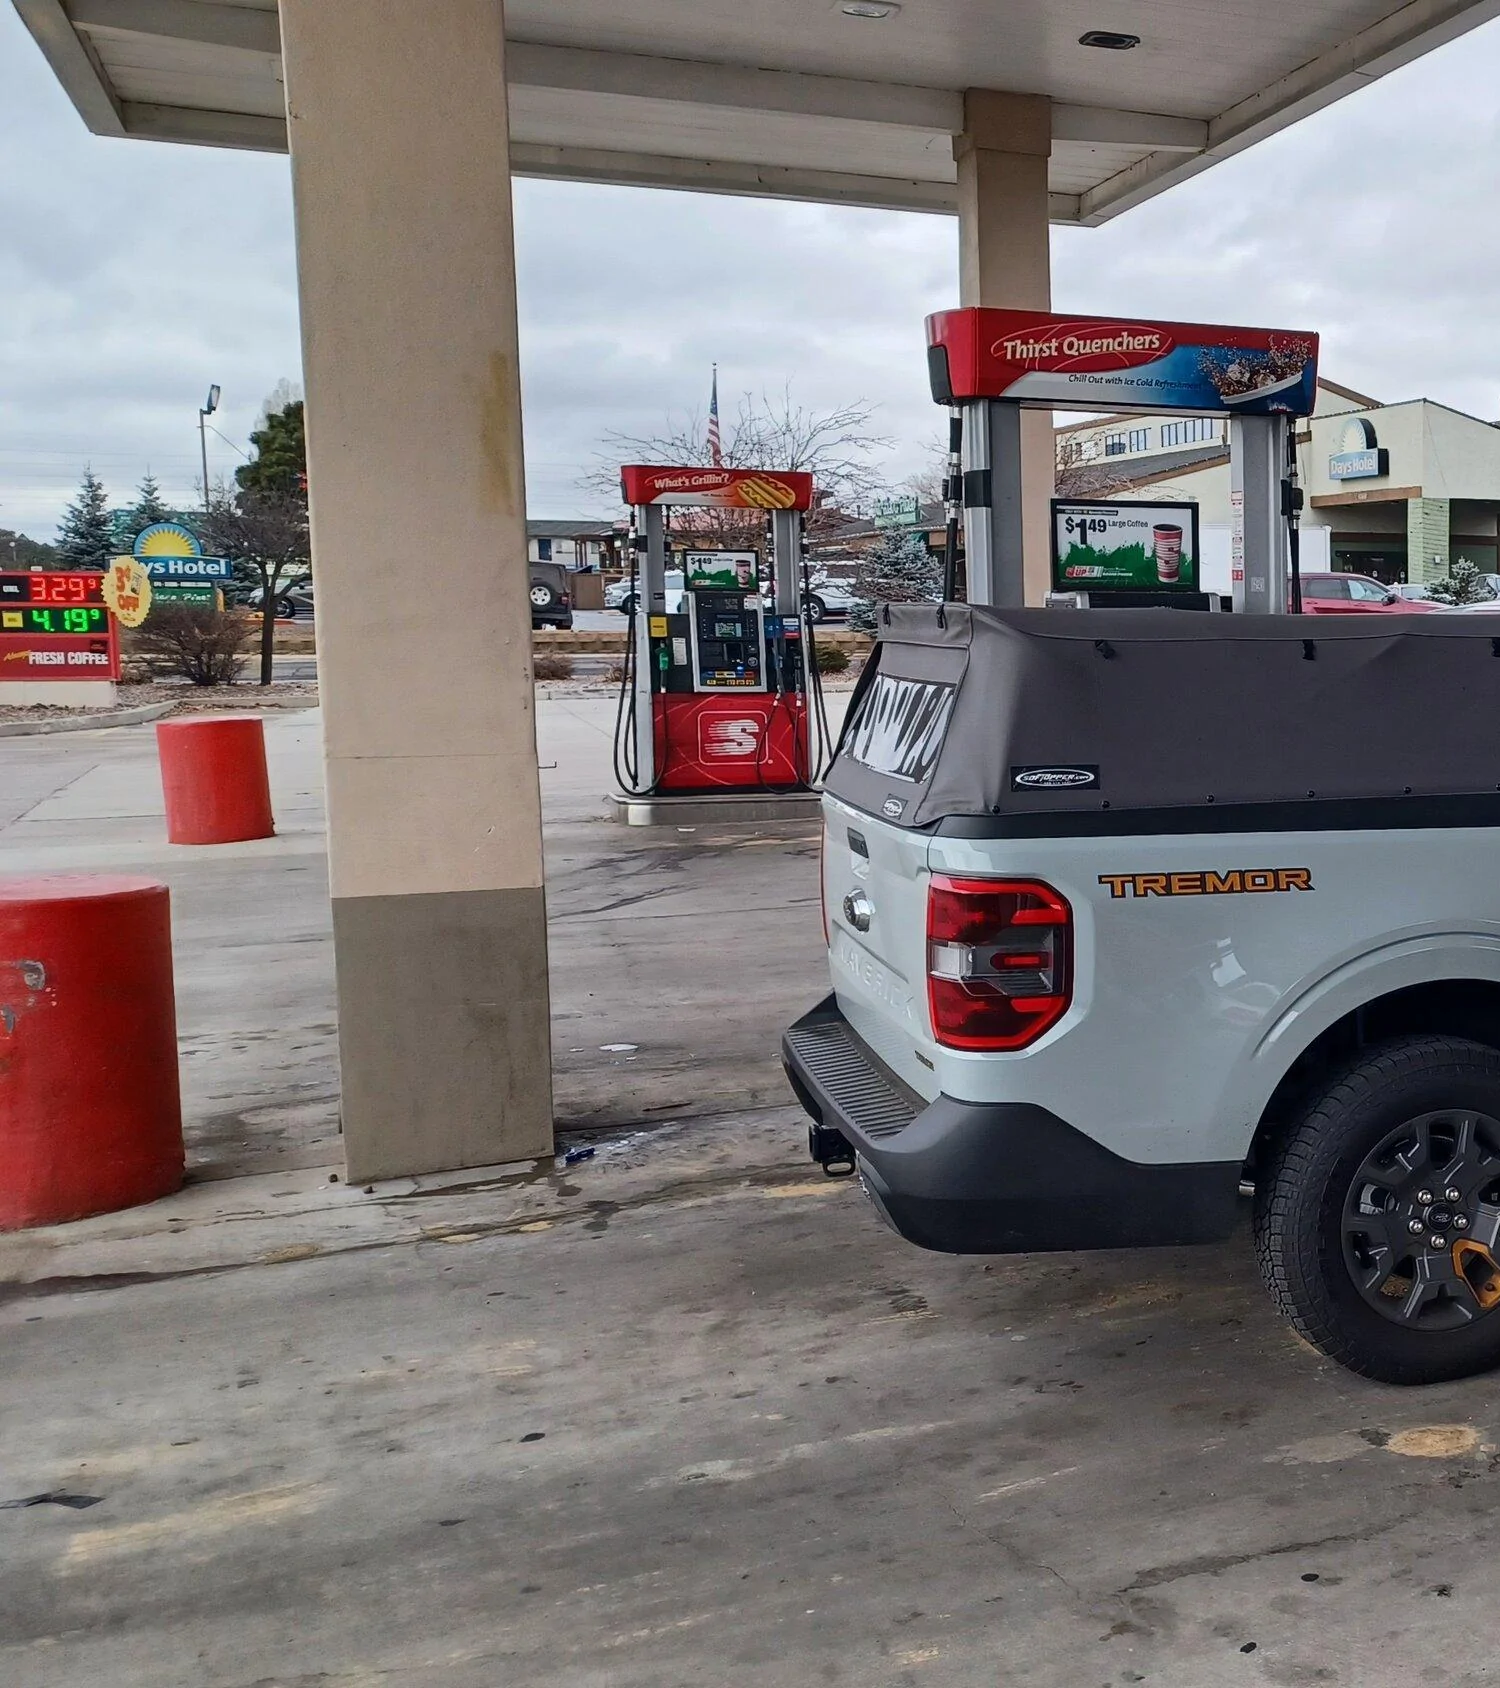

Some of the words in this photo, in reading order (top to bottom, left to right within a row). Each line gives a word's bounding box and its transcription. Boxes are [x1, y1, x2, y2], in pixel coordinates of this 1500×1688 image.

[1004, 337, 1059, 360] Thirst
[1062, 331, 1160, 356] Quenchers
[1068, 374, 1087, 384] Chill
[1088, 375, 1103, 384] Out
[1105, 376, 1122, 385] with
[1136, 378, 1153, 387] Cold
[1331, 460, 1352, 475] Days
[1353, 455, 1376, 471] Hotel
[654, 476, 689, 489] What's
[1108, 519, 1126, 528] Large
[1127, 519, 1148, 528] Coffee
[168, 560, 226, 575] Hotel
[29, 652, 64, 666] FRESH
[67, 651, 109, 665] COFFEE
[1097, 867, 1316, 899] TREMOR
